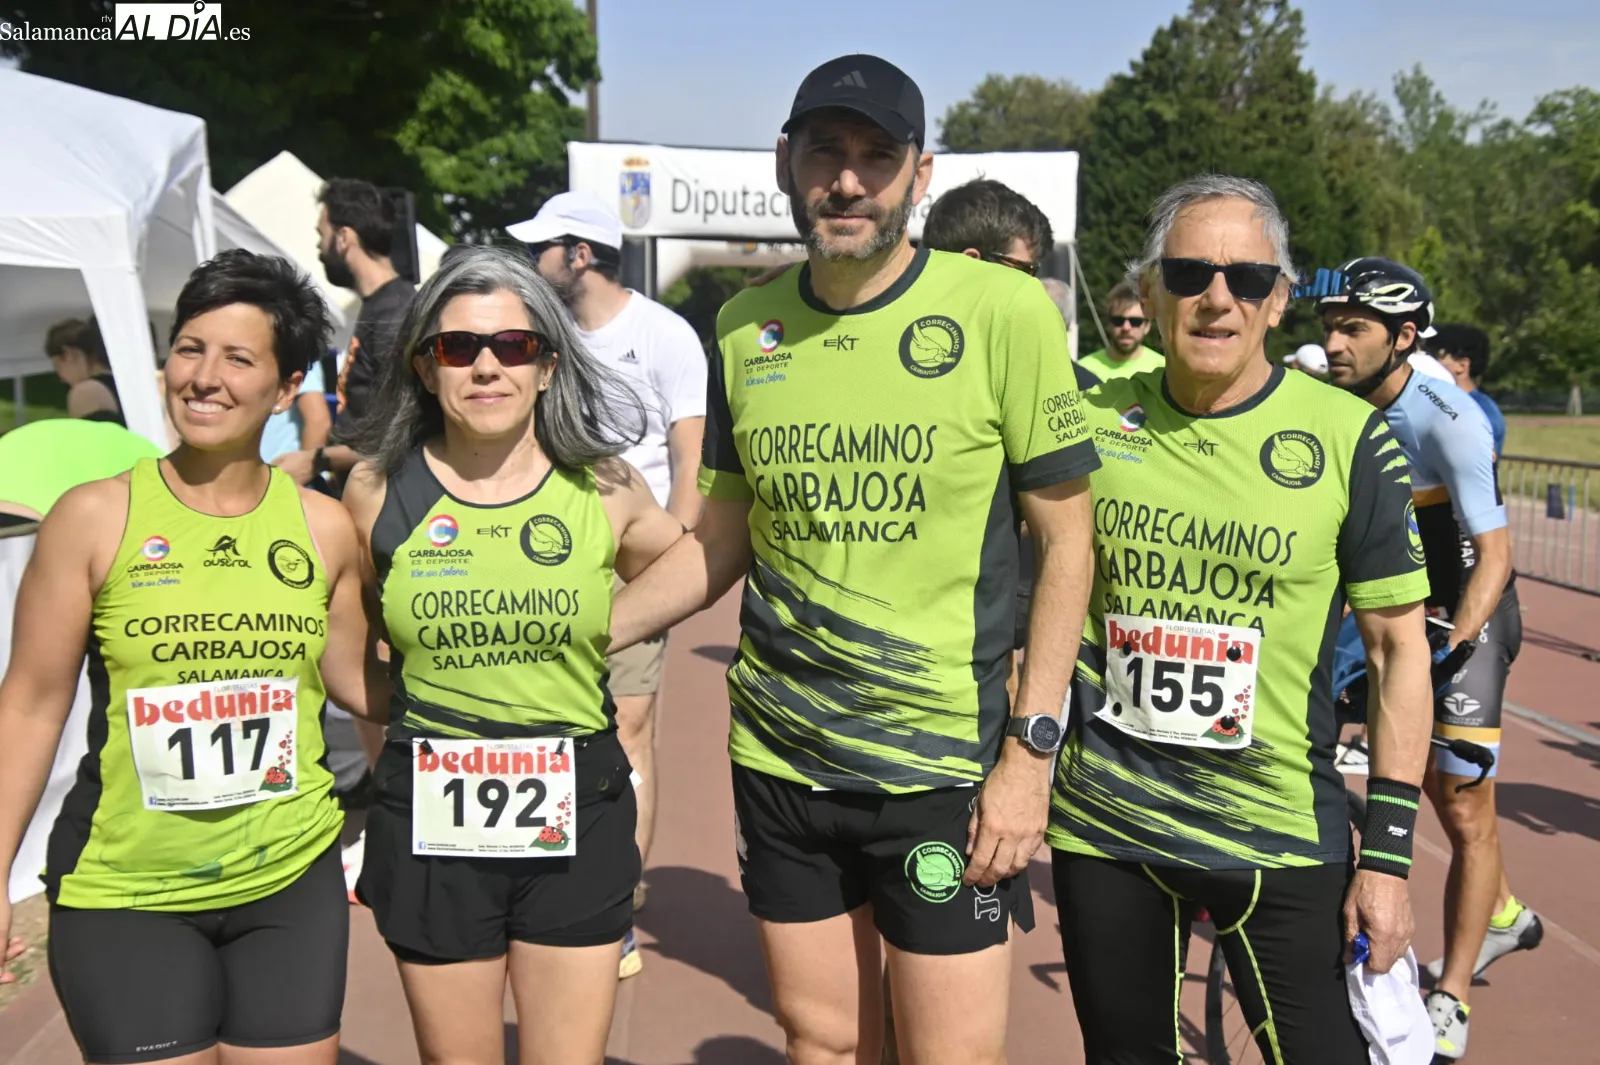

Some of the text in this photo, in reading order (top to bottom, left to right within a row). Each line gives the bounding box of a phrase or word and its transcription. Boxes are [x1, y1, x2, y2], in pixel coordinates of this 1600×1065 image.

[671, 177, 791, 223] Diputaci
[920, 318, 960, 353] CORRECAMINOS
[744, 352, 792, 367] CARBAJOSA
[757, 361, 789, 372] DEPORTE
[1418, 384, 1459, 421] ORBEA
[749, 422, 938, 467] CORRECAMINOS
[1095, 427, 1154, 447] CARBAJOSA
[1095, 435, 1148, 453] ES DEPORTE
[1280, 433, 1321, 469] CORRECAMINOS
[755, 471, 927, 513] CARBAJOSA
[772, 519, 918, 543] SALAMANCA
[1093, 497, 1298, 567] CORRECAMINOS
[127, 562, 184, 573] CARBAJOSA
[408, 549, 474, 558] CARBAJOSA
[1098, 544, 1275, 609] CARBAJOSA
[411, 588, 579, 620] CORRECAMINOS
[1104, 592, 1266, 638] SALAMANCA
[124, 612, 325, 638] CORRECAMINOS
[417, 620, 572, 651] CARBAJOSA
[151, 640, 307, 663] CARBAJOSA
[1108, 620, 1254, 665] bedunia
[432, 649, 567, 671] SALAMANCA
[177, 669, 285, 685] SALAMANCA
[1126, 656, 1226, 718] 155
[132, 684, 293, 728] bedunia
[167, 717, 271, 781] 117
[418, 746, 570, 775] bedunia
[443, 777, 548, 828] 192
